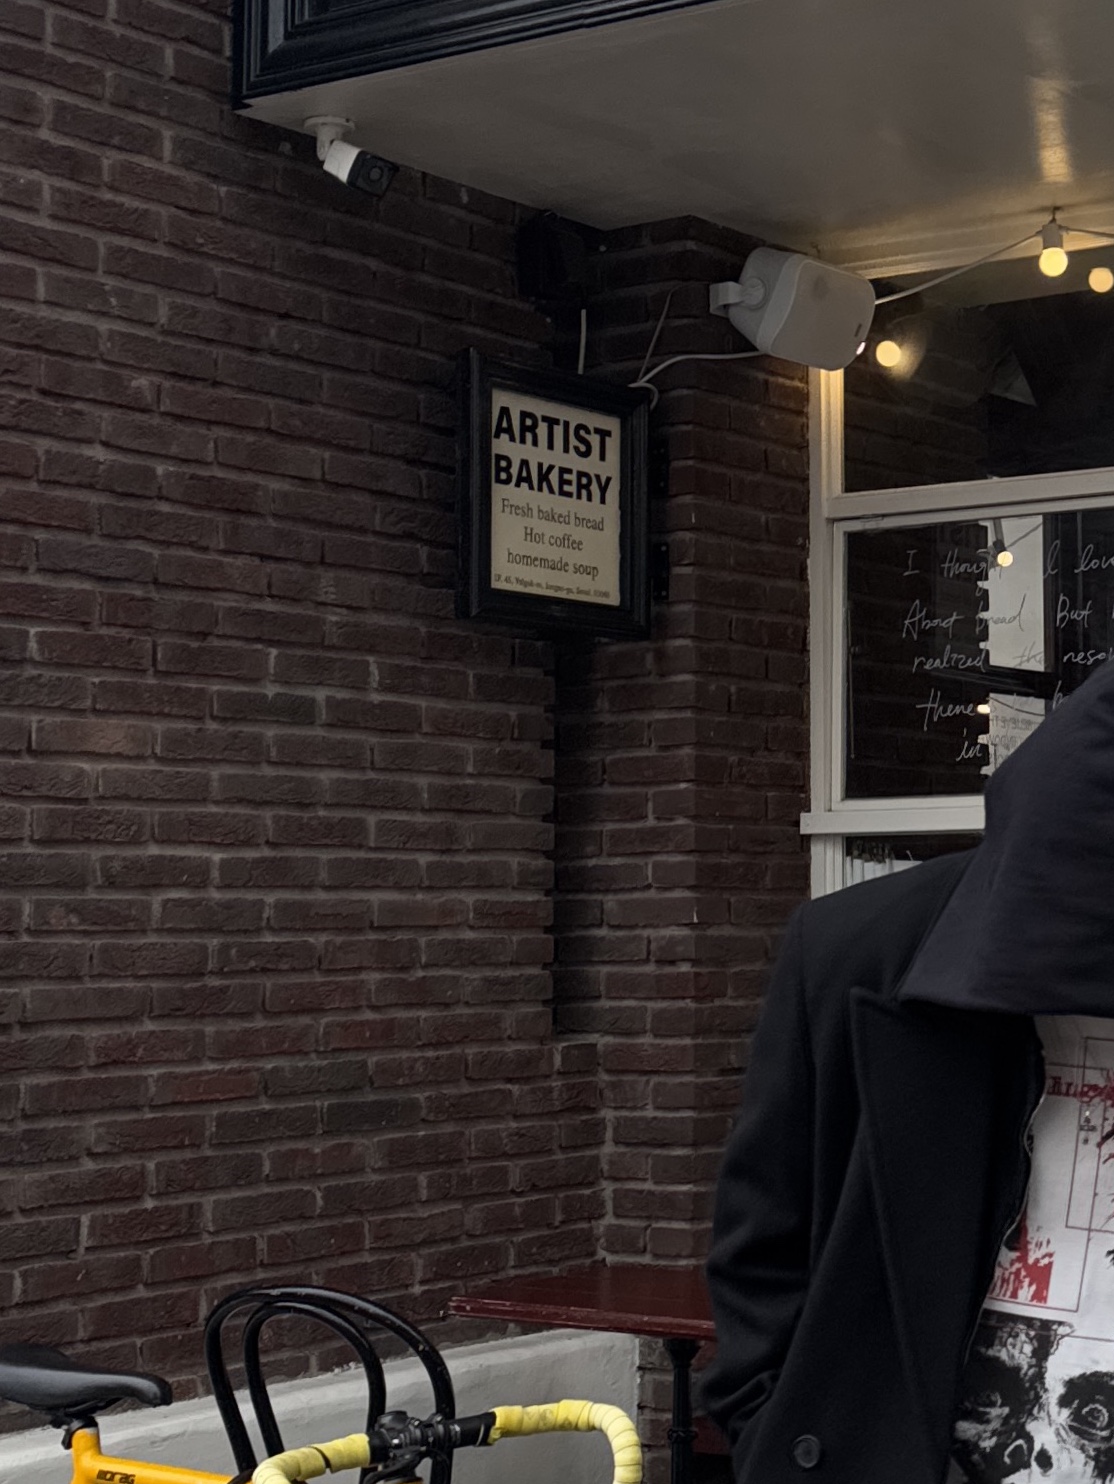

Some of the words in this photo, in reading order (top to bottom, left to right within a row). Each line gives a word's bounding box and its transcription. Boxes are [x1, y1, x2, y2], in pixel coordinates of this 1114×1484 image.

[493, 405, 611, 462] ARTIST
[493, 453, 612, 505] BAKERY
[501, 498, 533, 519] Fresh
[537, 505, 570, 525] baked
[574, 512, 604, 531] bread
[523, 526, 545, 544] Hot
[548, 533, 583, 550] coffee
[507, 548, 569, 573] homemade
[572, 561, 599, 580] soup
[903, 549, 920, 576] I
